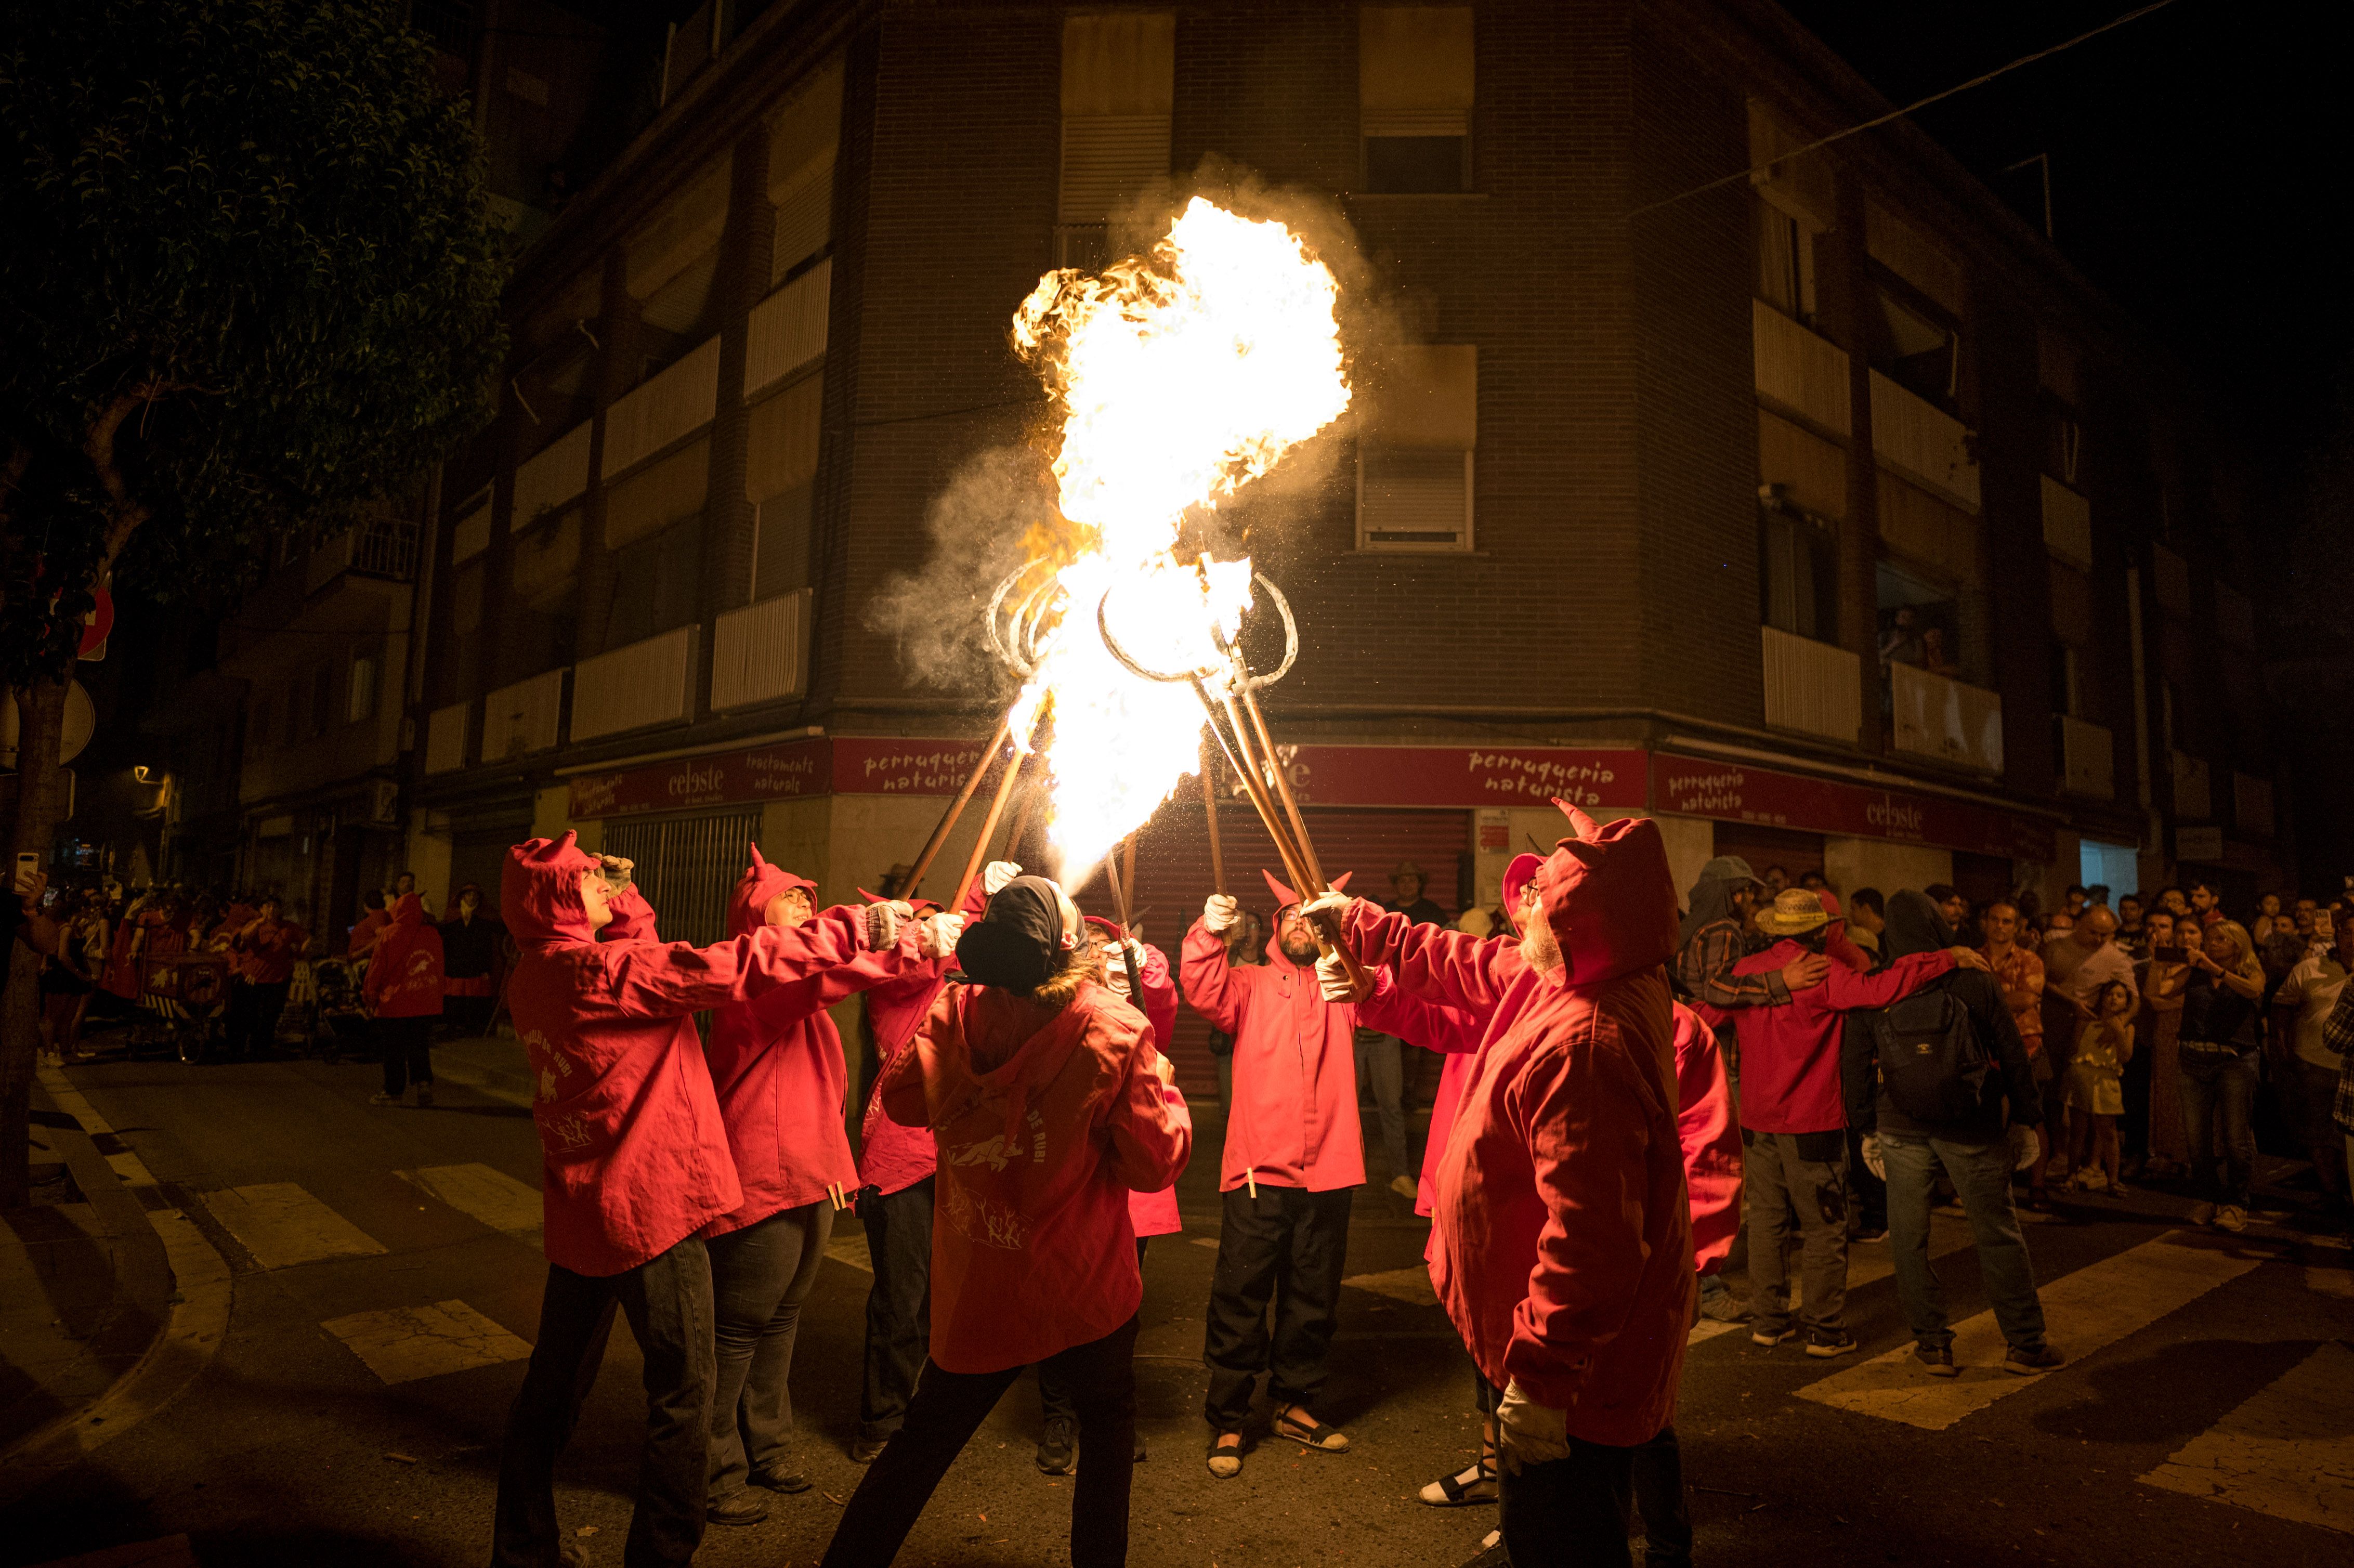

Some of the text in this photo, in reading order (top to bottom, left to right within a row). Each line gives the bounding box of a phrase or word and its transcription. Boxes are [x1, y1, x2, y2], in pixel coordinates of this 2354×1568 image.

[746, 753, 814, 774] tractaments
[864, 751, 980, 778] perruquer
[1469, 751, 1614, 783] perruqueria
[754, 774, 801, 793] naturals
[883, 770, 966, 791] naturis
[1484, 775, 1601, 806] naturista
[1668, 767, 1745, 798] perruqueria
[1681, 790, 1743, 811] naturista
[1027, 1109, 1047, 1163] DE RUBI
